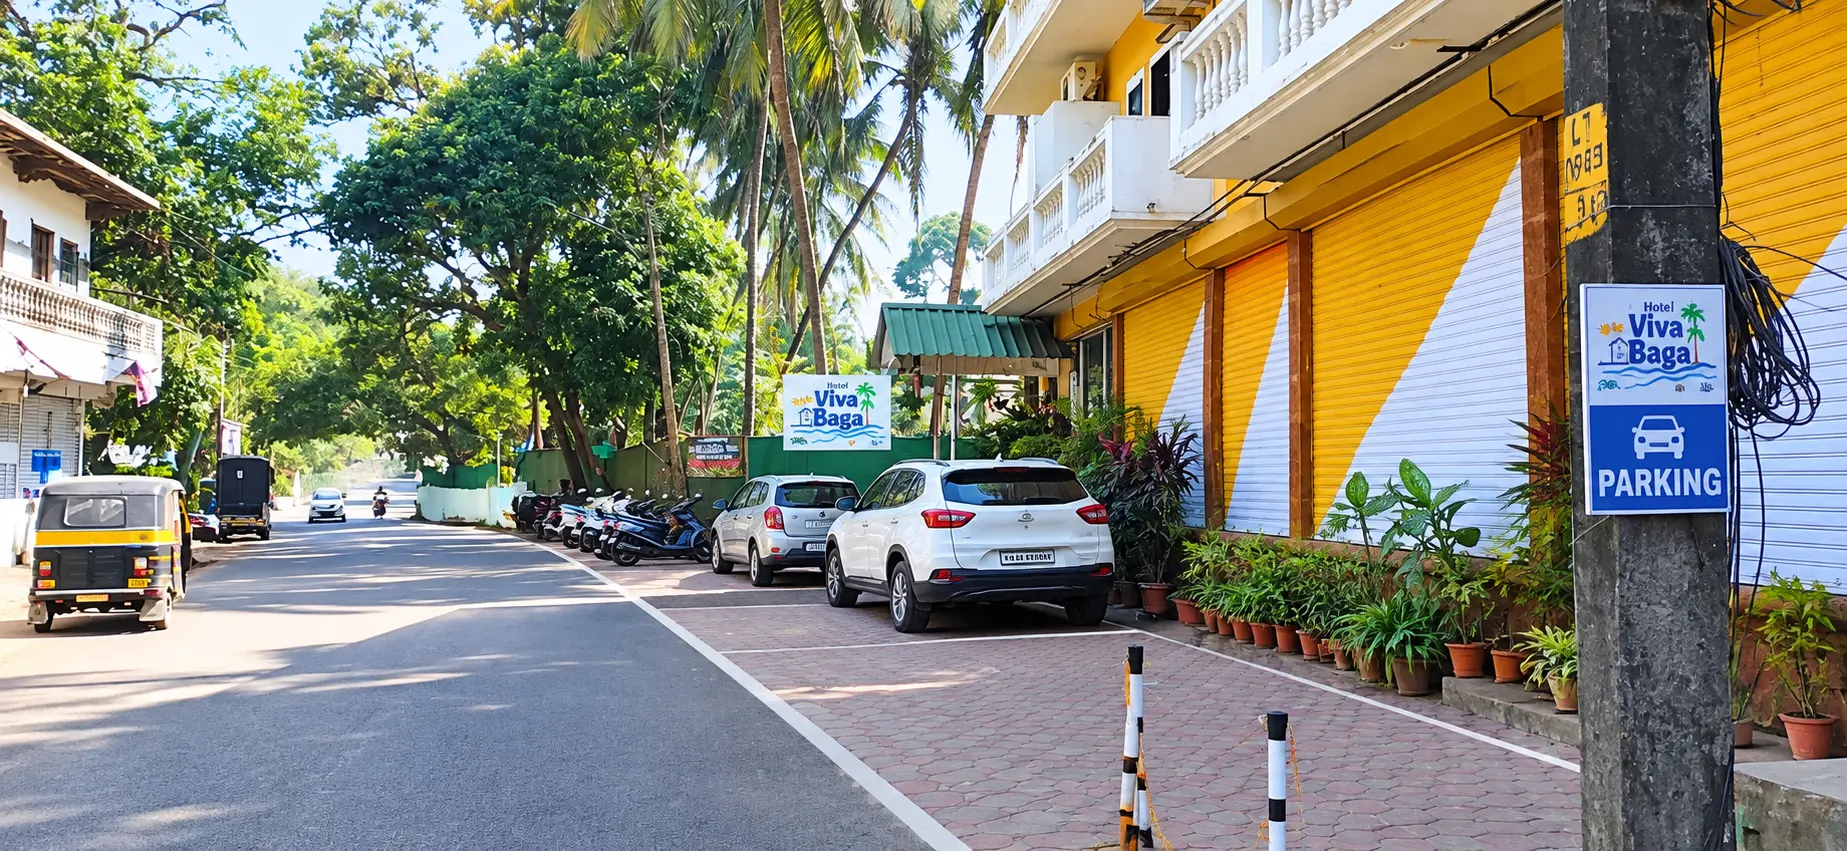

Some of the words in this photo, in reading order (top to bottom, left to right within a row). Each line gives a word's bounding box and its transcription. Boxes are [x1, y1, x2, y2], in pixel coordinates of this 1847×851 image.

[1643, 301, 1674, 313] Hotel
[1628, 313, 1684, 338] Viva
[1627, 339, 1691, 370] Baga
[827, 381, 848, 389] Hotel
[814, 389, 858, 408] Viva
[812, 408, 863, 430] Baga
[1598, 467, 1722, 497] PARKING
